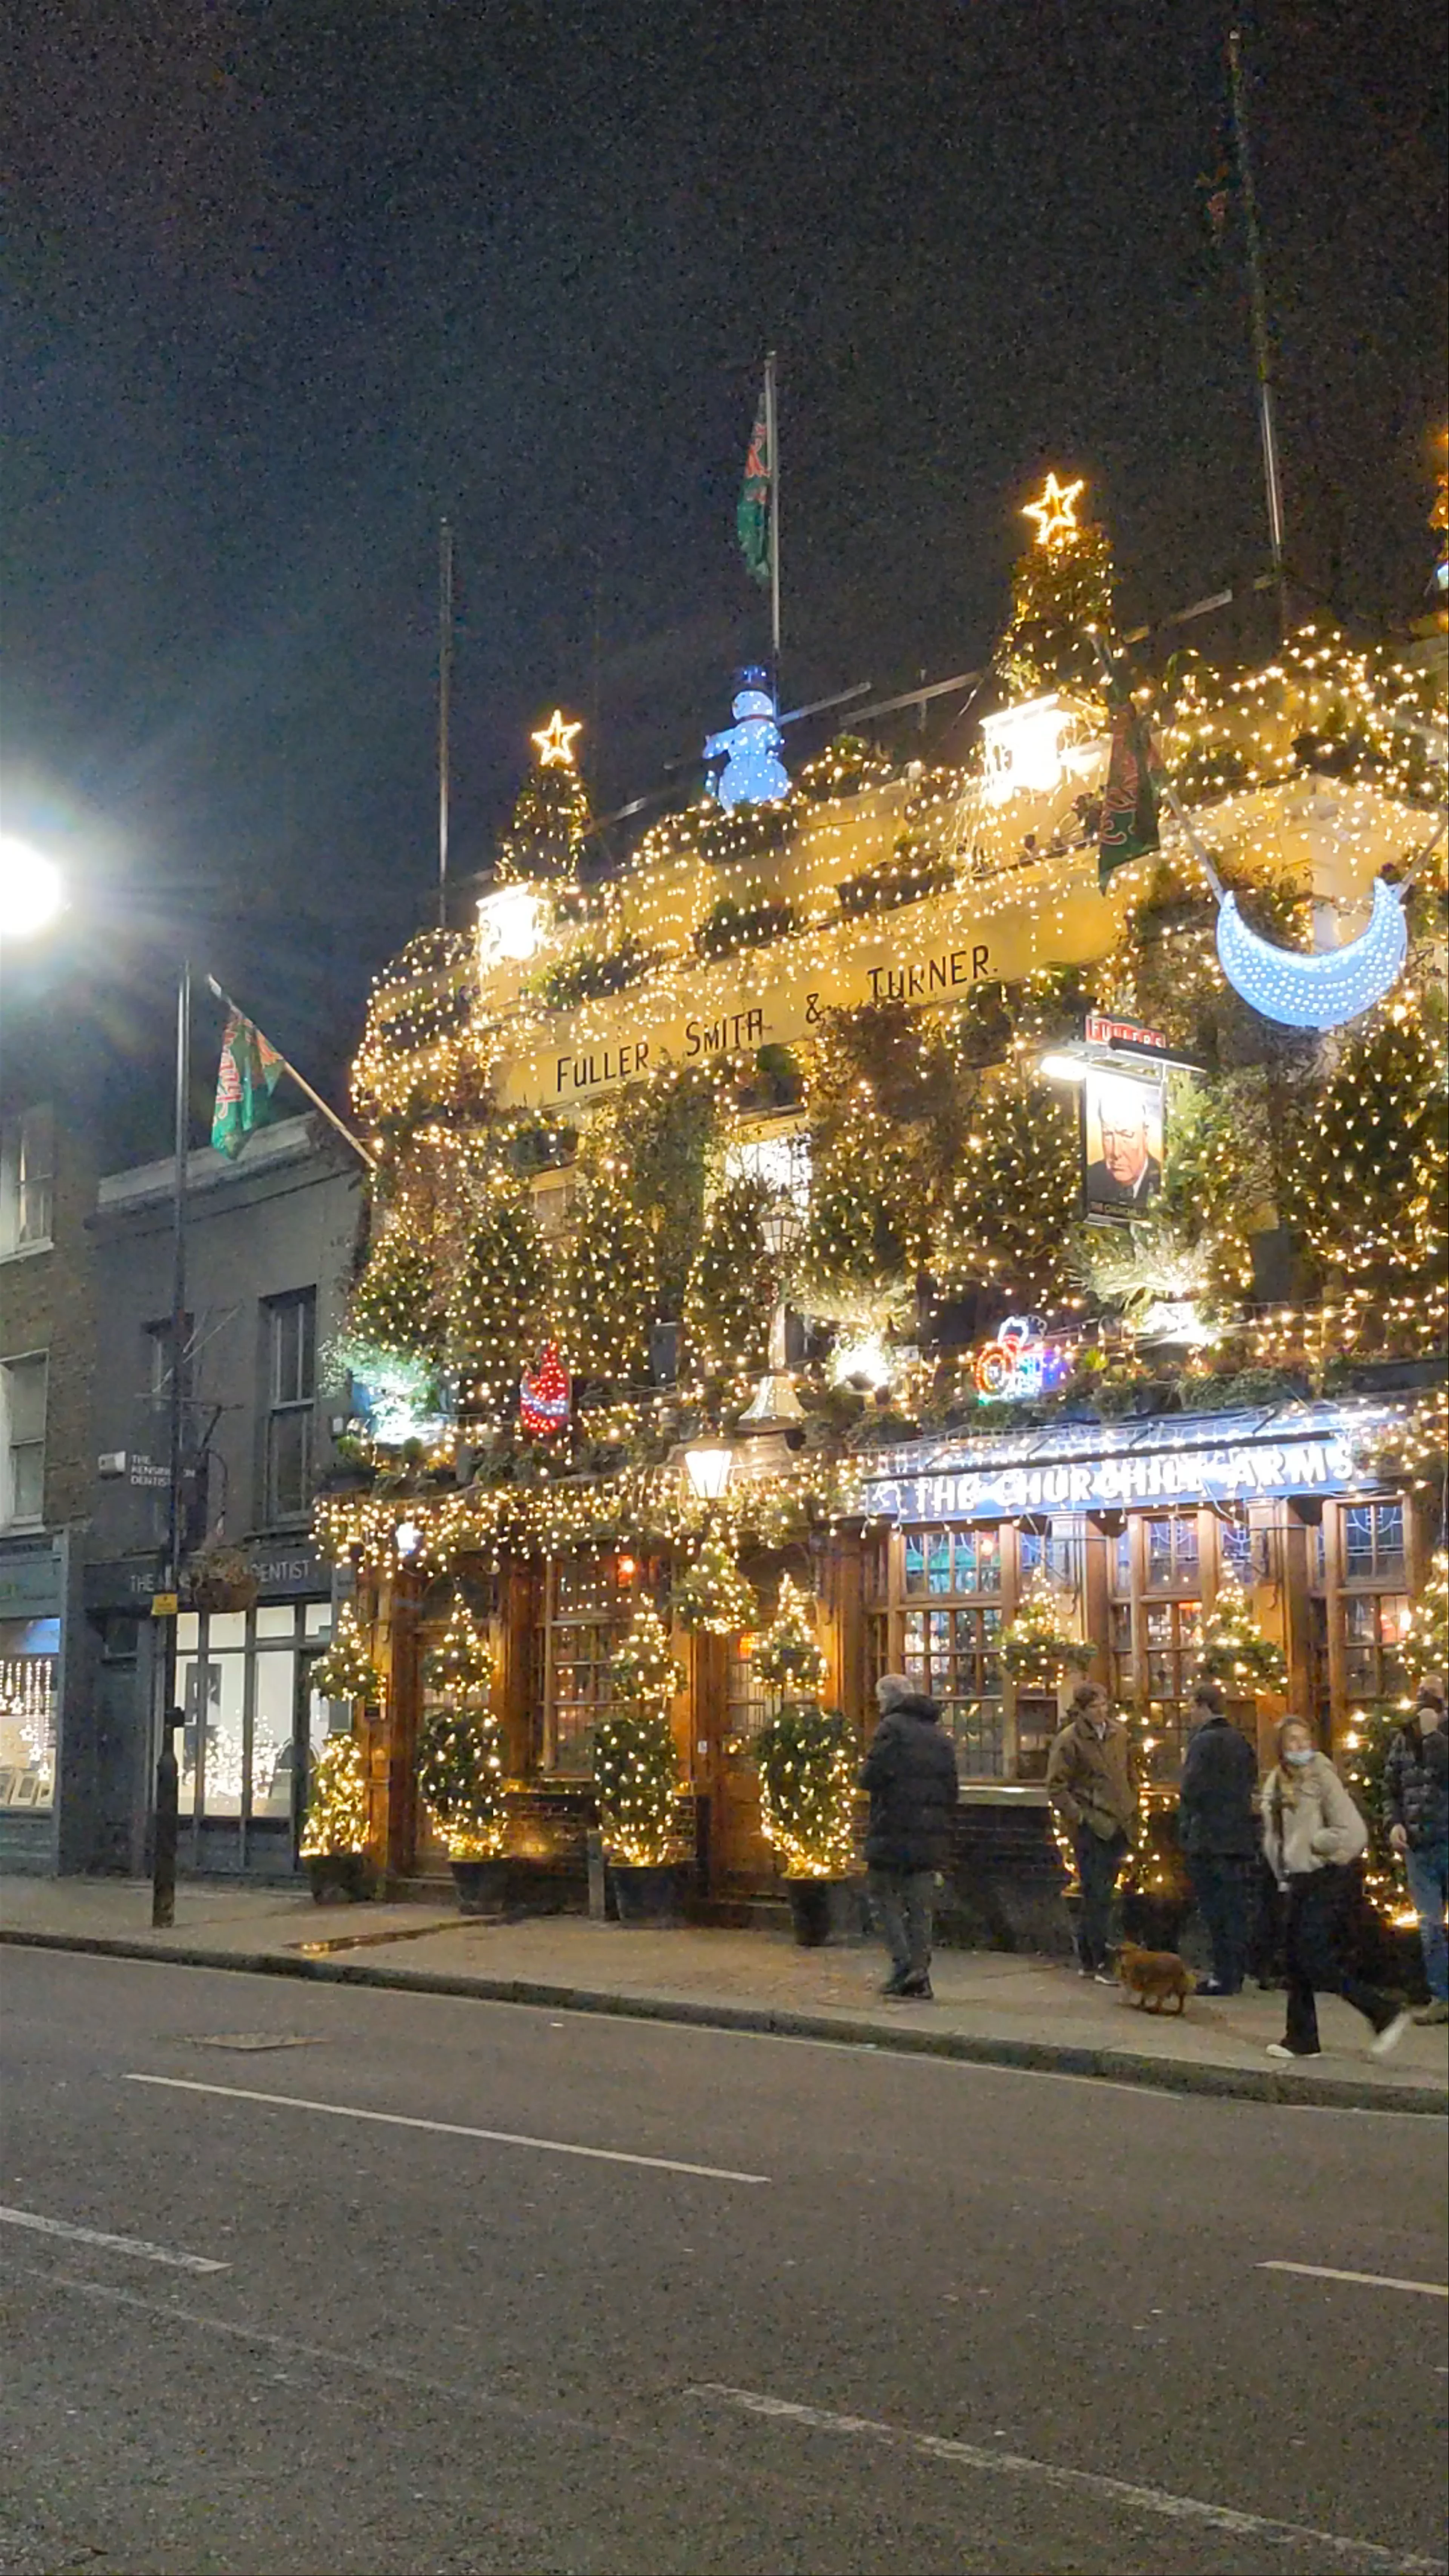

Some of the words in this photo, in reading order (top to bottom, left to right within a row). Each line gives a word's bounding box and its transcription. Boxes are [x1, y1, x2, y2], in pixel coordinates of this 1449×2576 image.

[557, 1041, 649, 1092] FULLER
[685, 1008, 763, 1057] SMITH
[806, 993, 821, 1023] &
[915, 1474, 977, 1513] THE
[995, 1455, 1204, 1508] CHURCHILL
[1227, 1443, 1352, 1486] ARMS
[131, 1573, 155, 1592] THE
